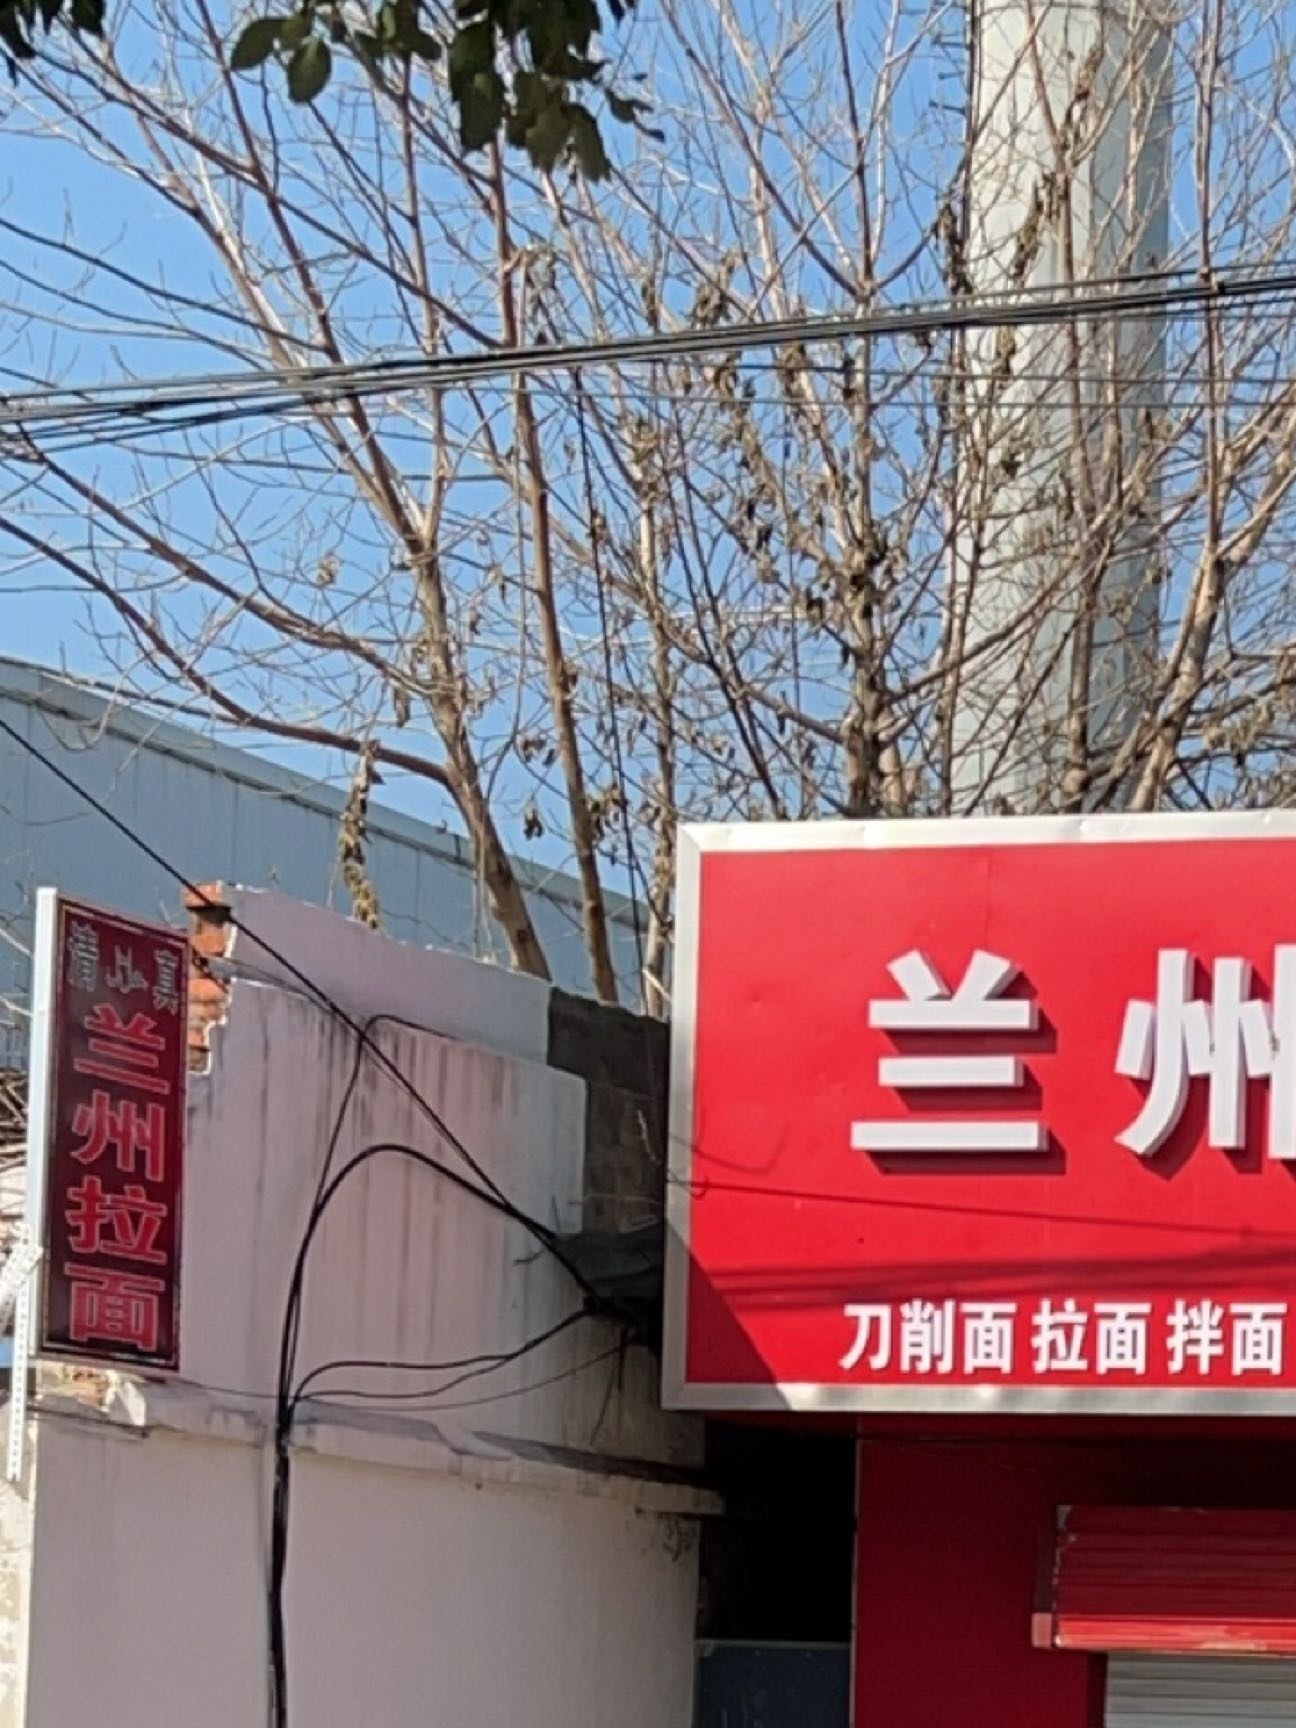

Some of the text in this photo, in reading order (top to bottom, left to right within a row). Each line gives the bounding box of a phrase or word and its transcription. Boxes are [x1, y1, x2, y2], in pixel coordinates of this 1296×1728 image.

[64, 1001, 170, 1352] 兰州拉面
[838, 1299, 1017, 1374] 刀削面
[1030, 1298, 1151, 1374] 拉面
[1166, 1299, 1287, 1376] 拌面
